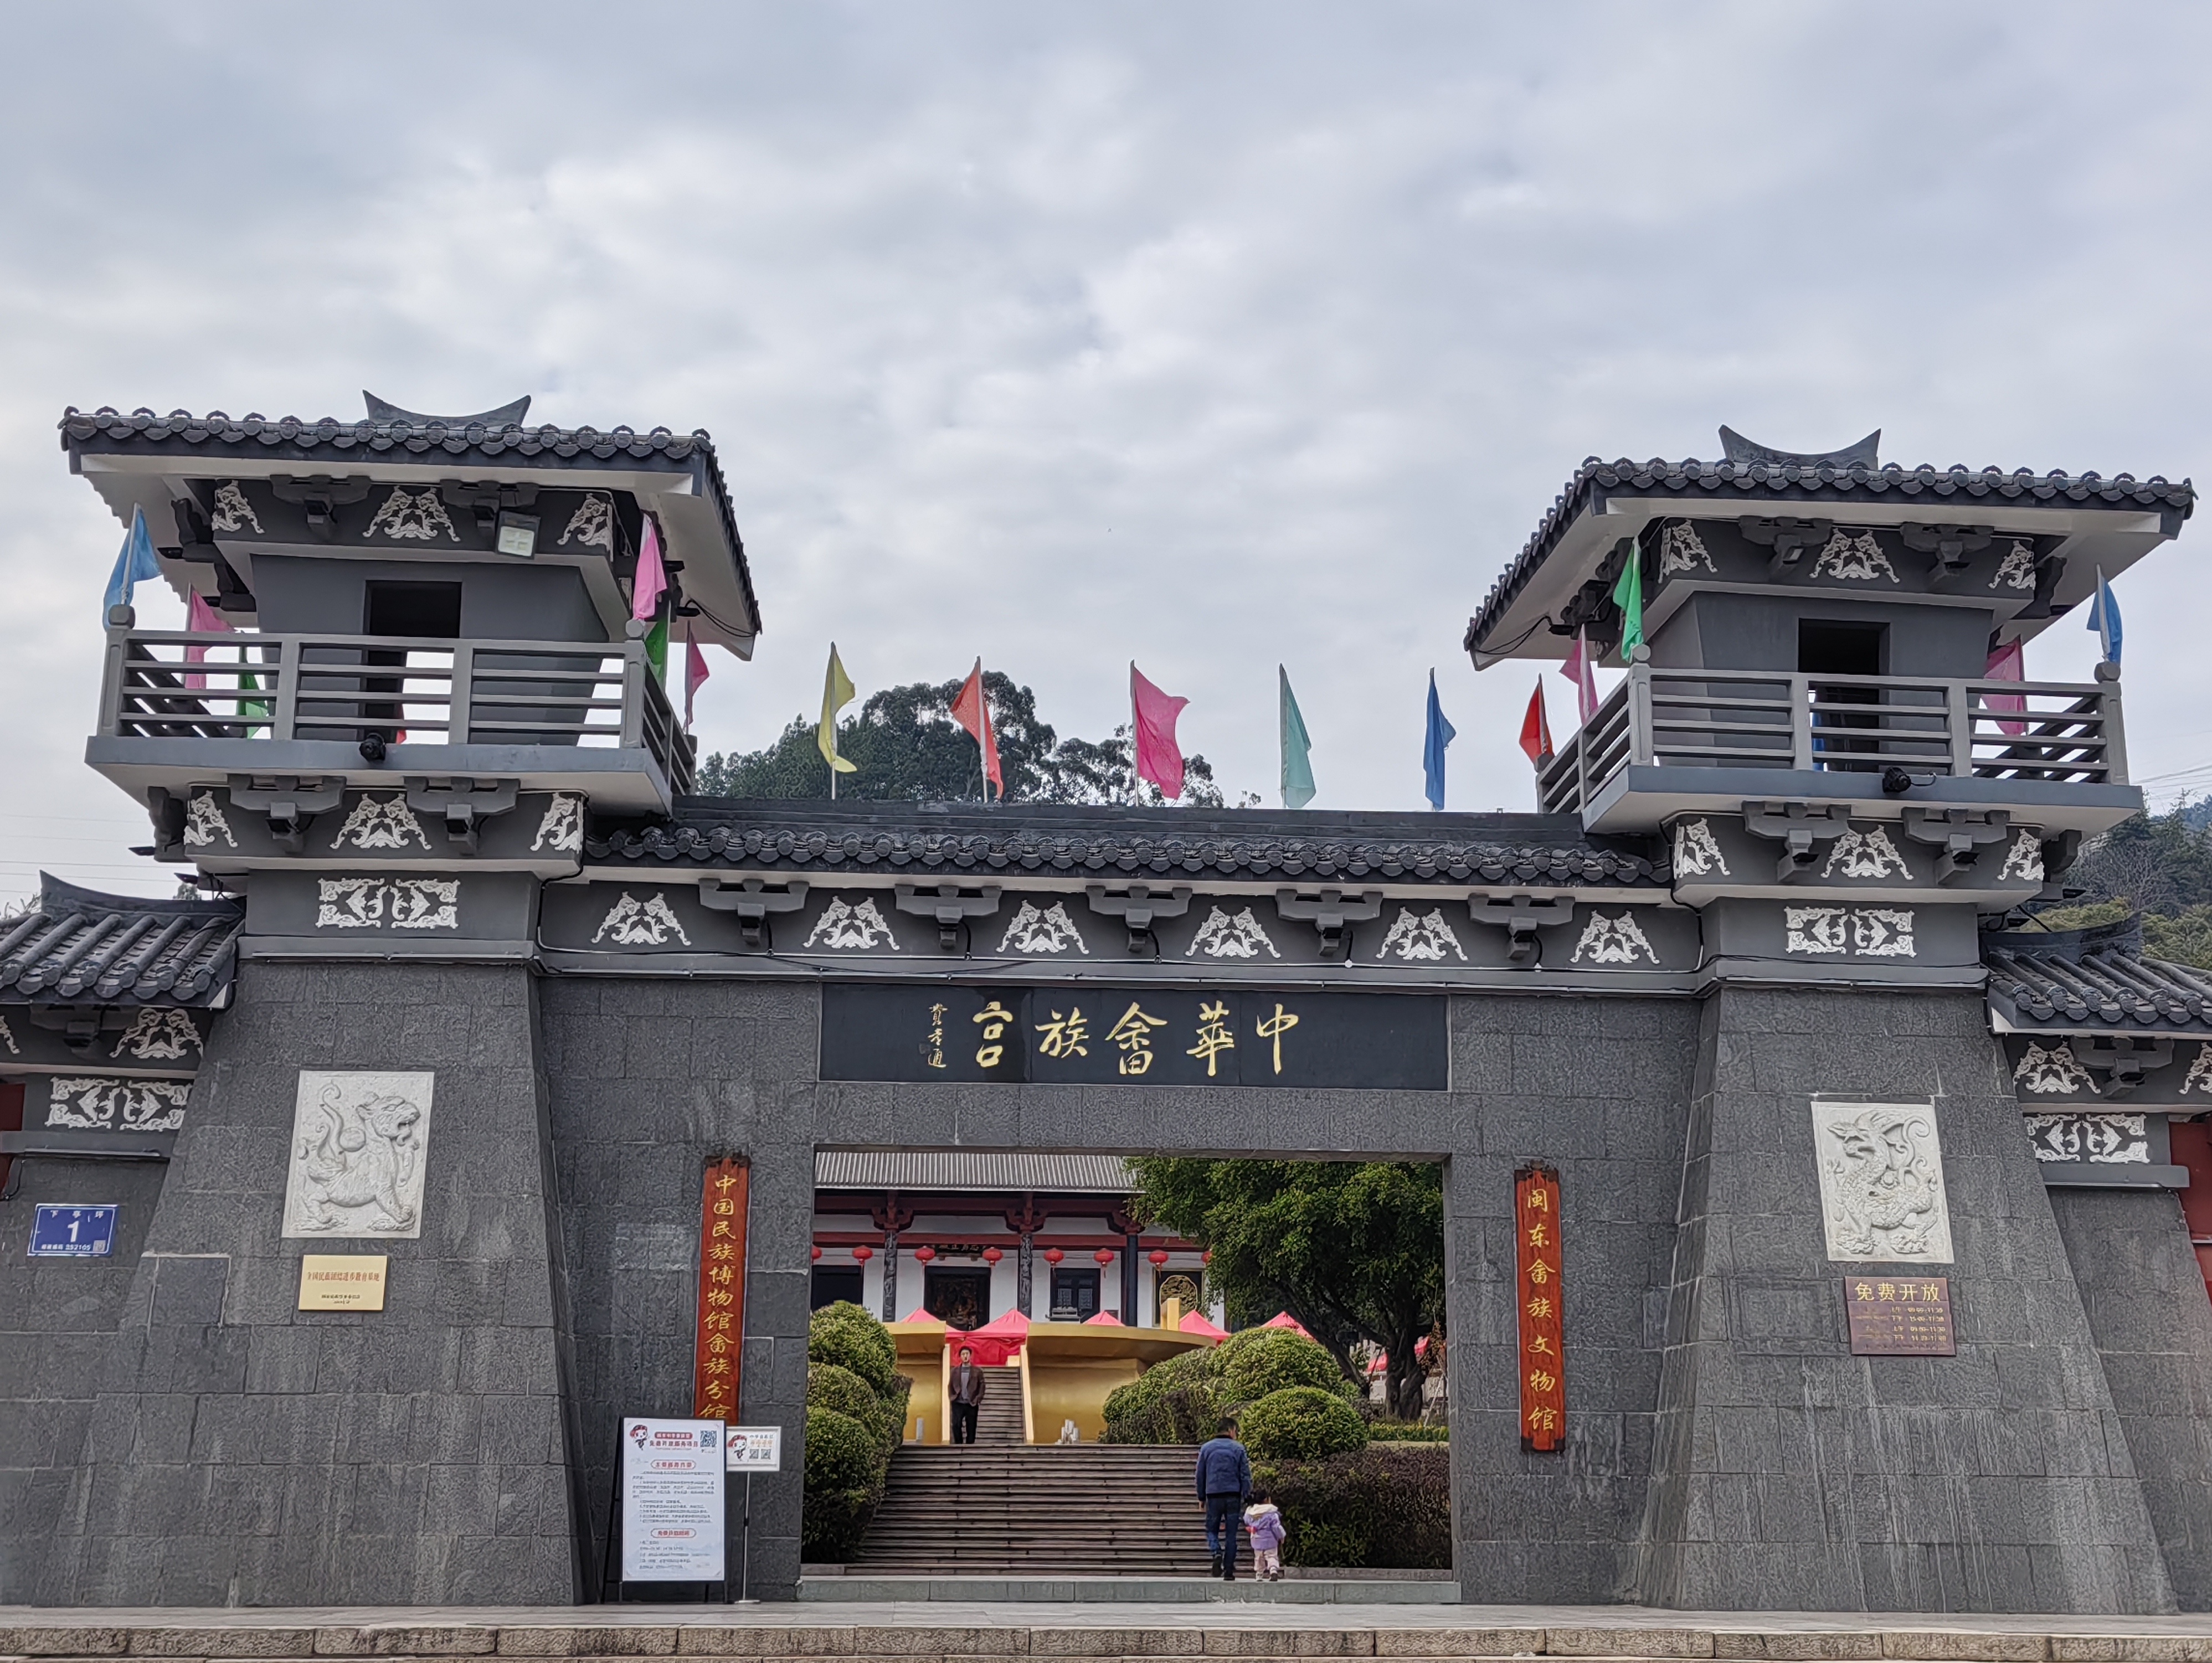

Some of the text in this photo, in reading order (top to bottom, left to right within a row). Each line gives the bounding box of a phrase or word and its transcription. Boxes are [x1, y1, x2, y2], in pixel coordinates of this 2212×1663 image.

[67, 1220, 79, 1243] 1
[1855, 1282, 1941, 1302] 免费开放
[1526, 1188, 1558, 1430] 闽东畲族文物馆
